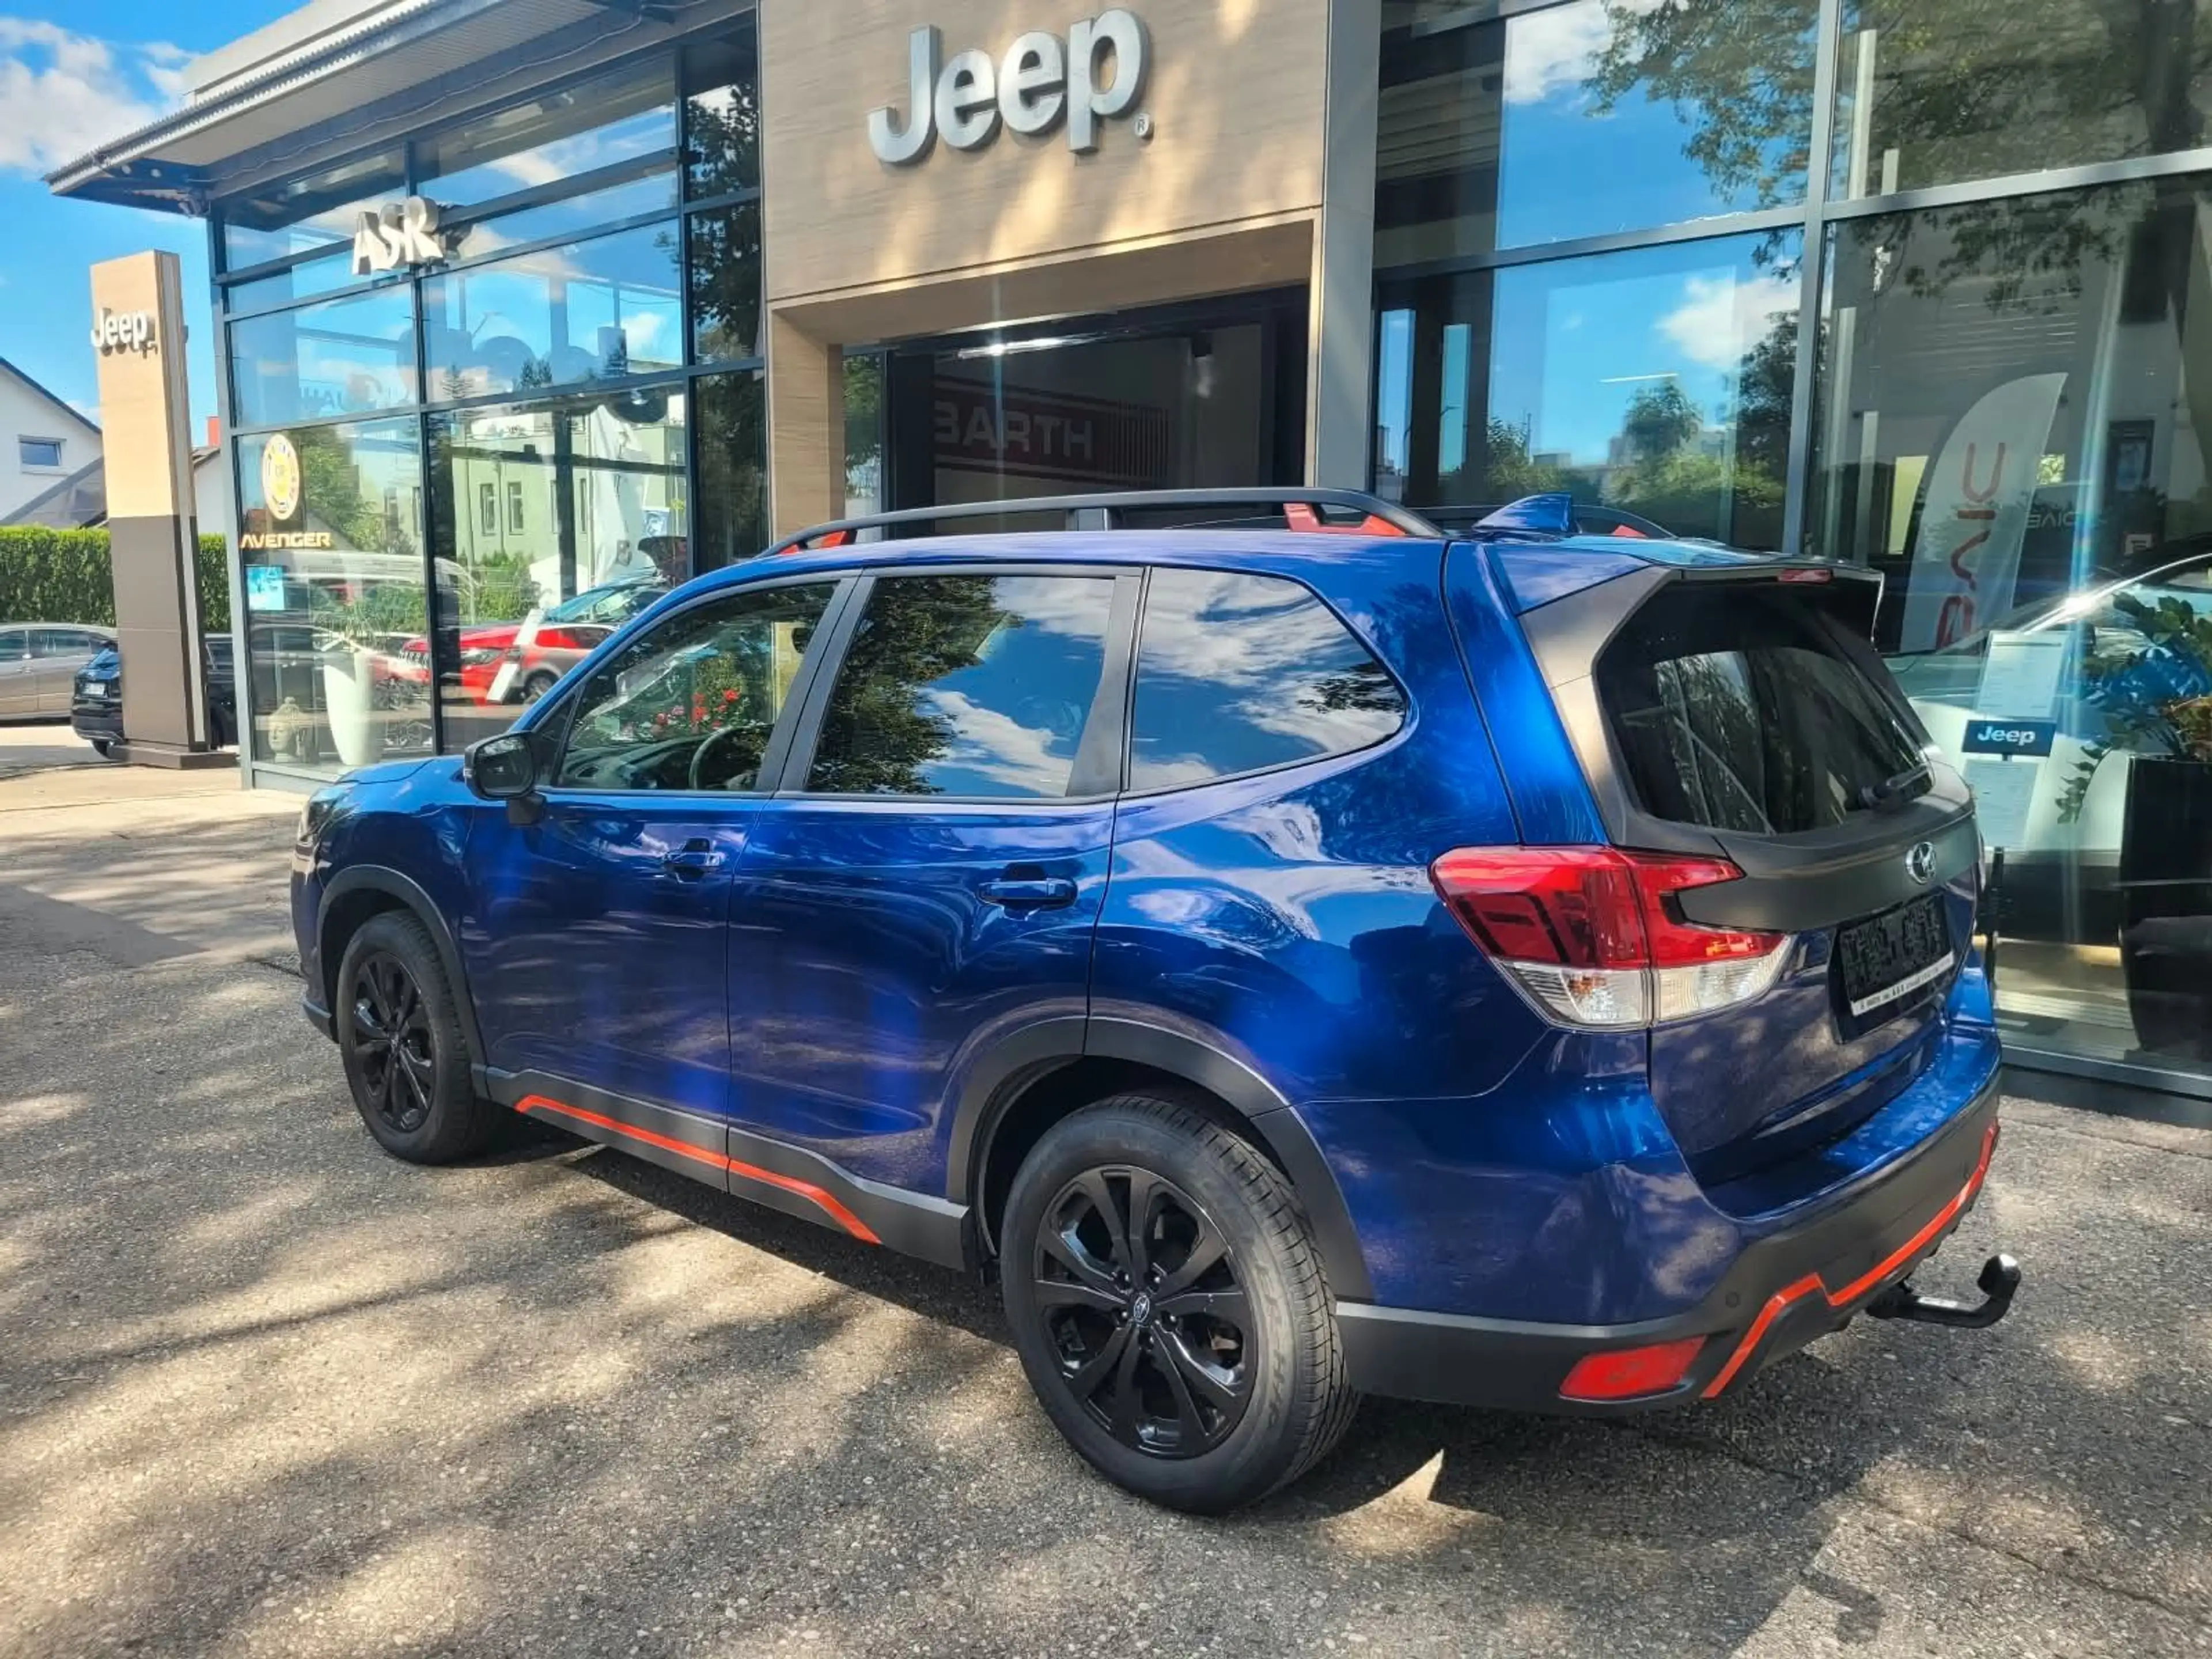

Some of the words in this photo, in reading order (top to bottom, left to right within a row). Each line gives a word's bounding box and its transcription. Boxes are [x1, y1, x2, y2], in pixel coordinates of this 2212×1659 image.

[352, 196, 446, 275] ASR
[90, 308, 148, 349] Jeep
[241, 532, 331, 548] AVENGER
[1978, 726, 2036, 745] Jeep
